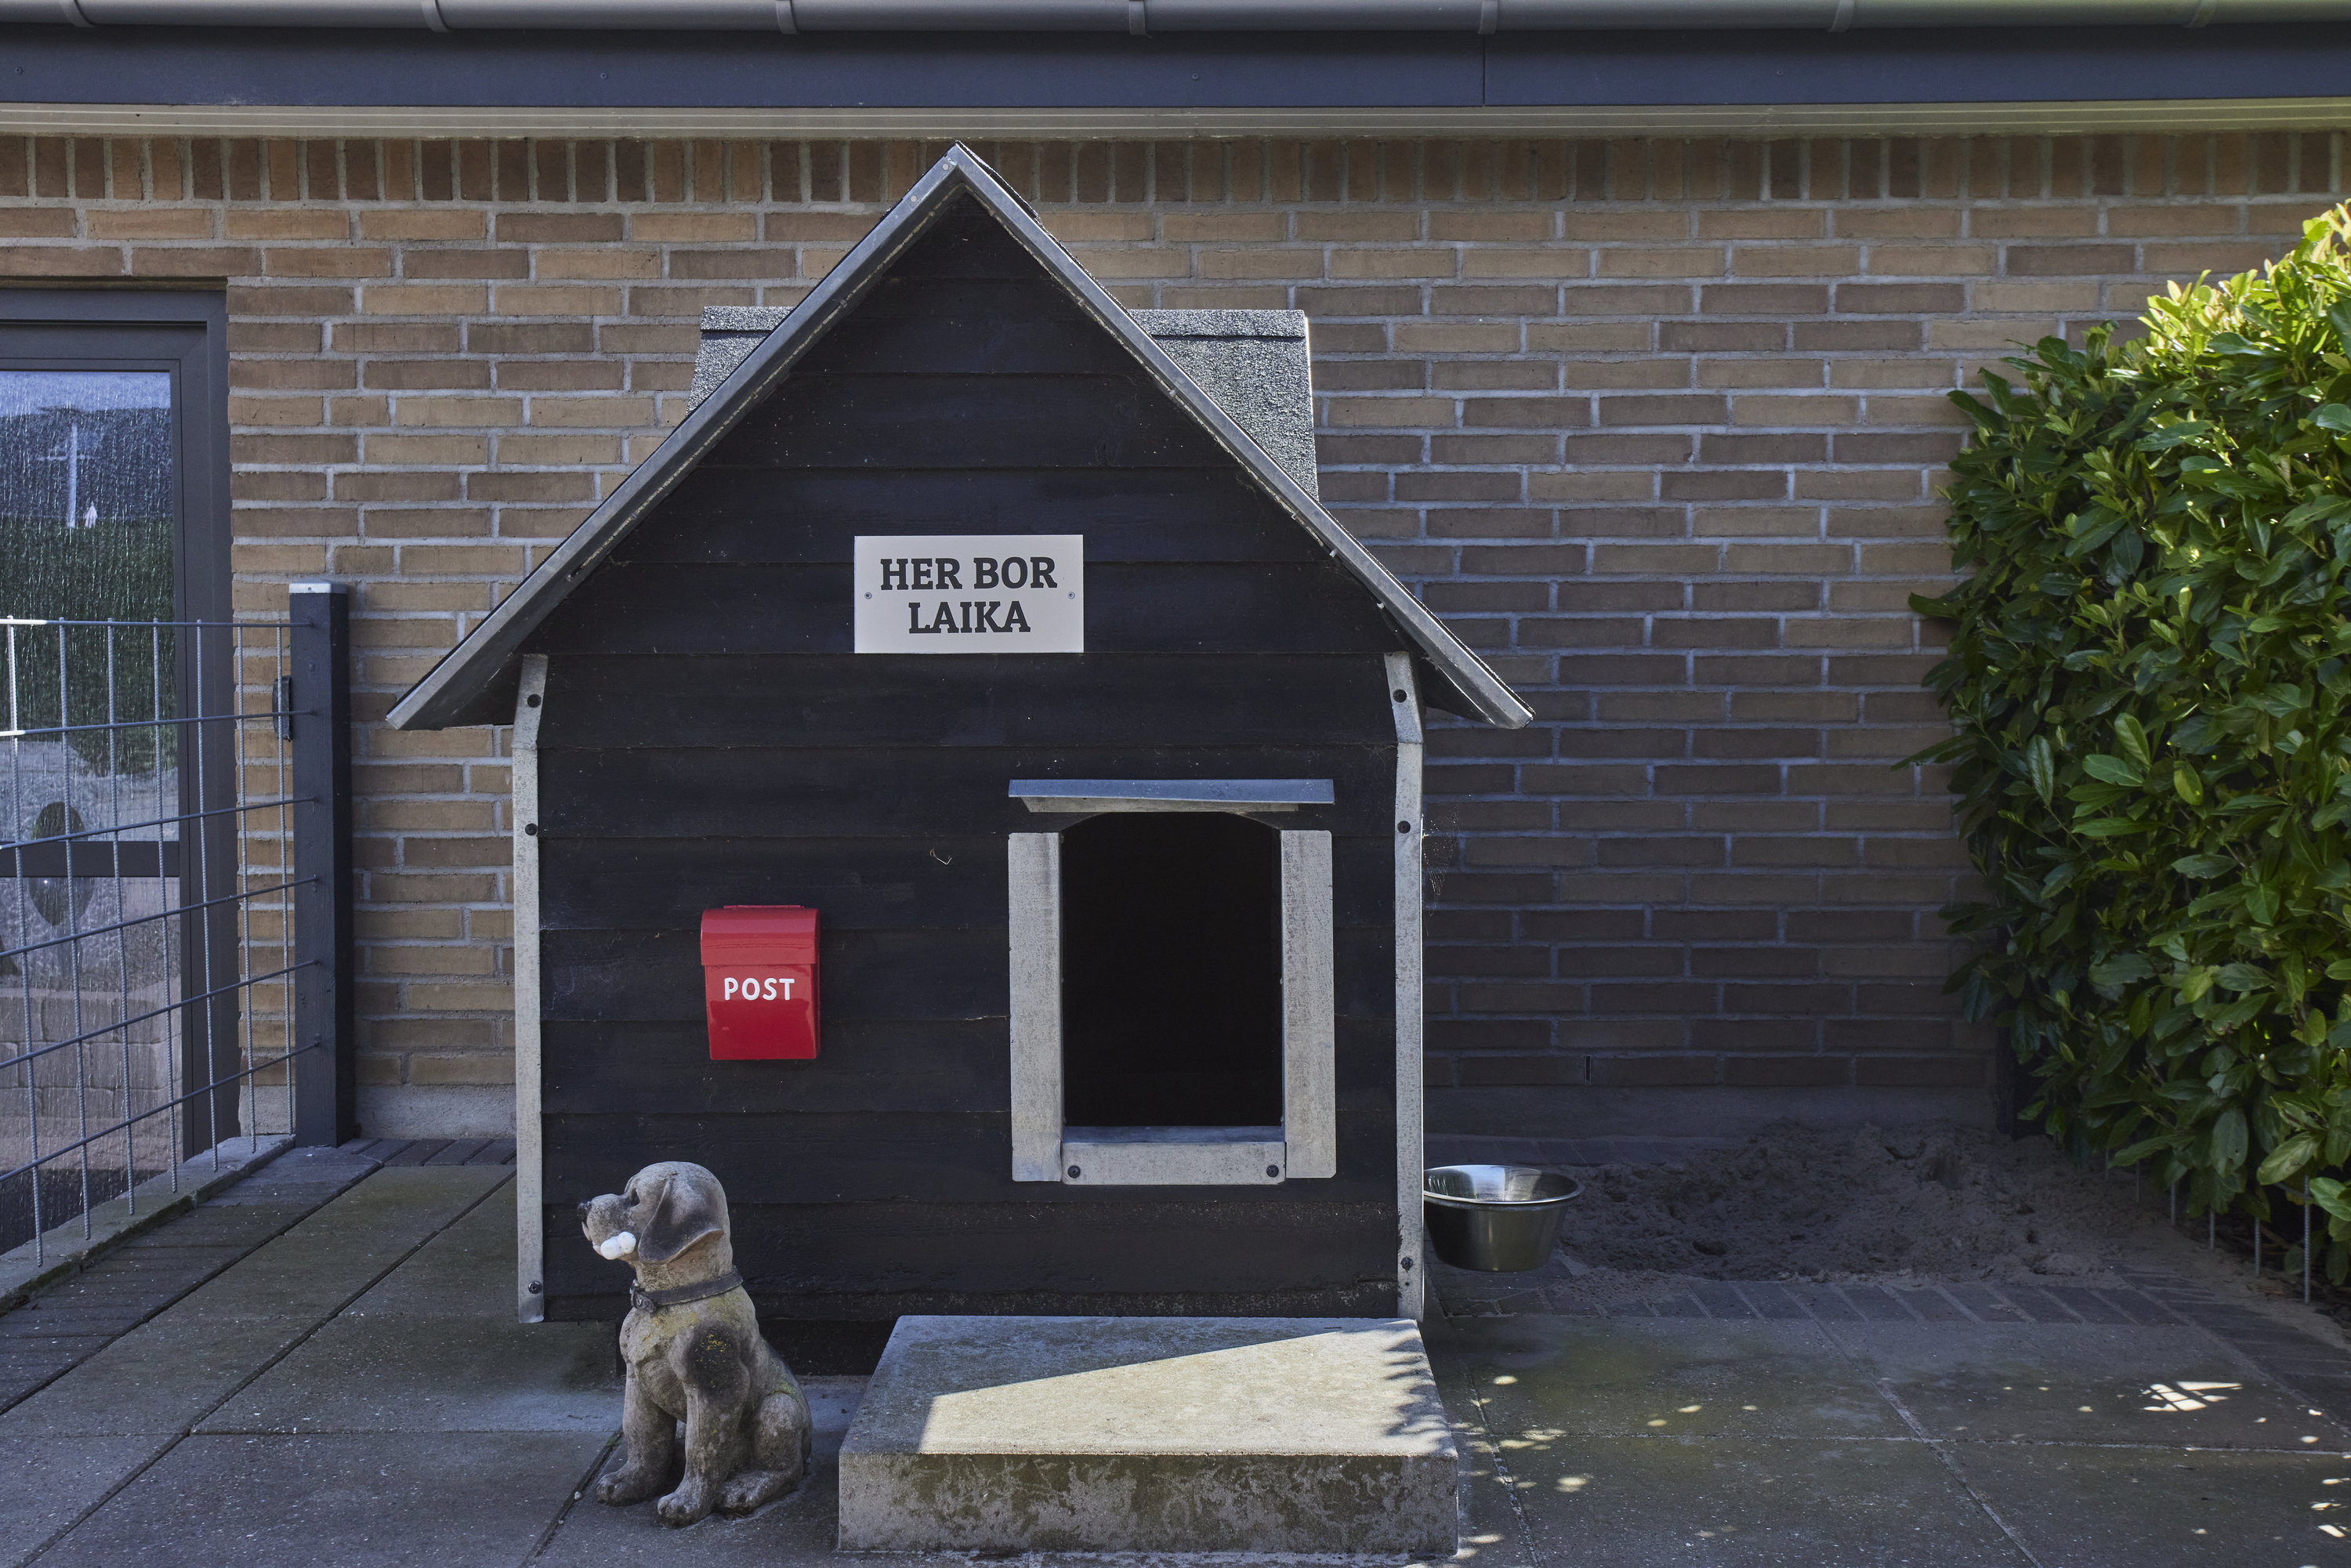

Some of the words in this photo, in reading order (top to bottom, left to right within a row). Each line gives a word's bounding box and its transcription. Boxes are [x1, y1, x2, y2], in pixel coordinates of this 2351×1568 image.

[880, 557, 963, 591] HER
[973, 556, 1058, 589] BOR
[907, 600, 1031, 634] LAIKA
[724, 977, 795, 1001] POST
